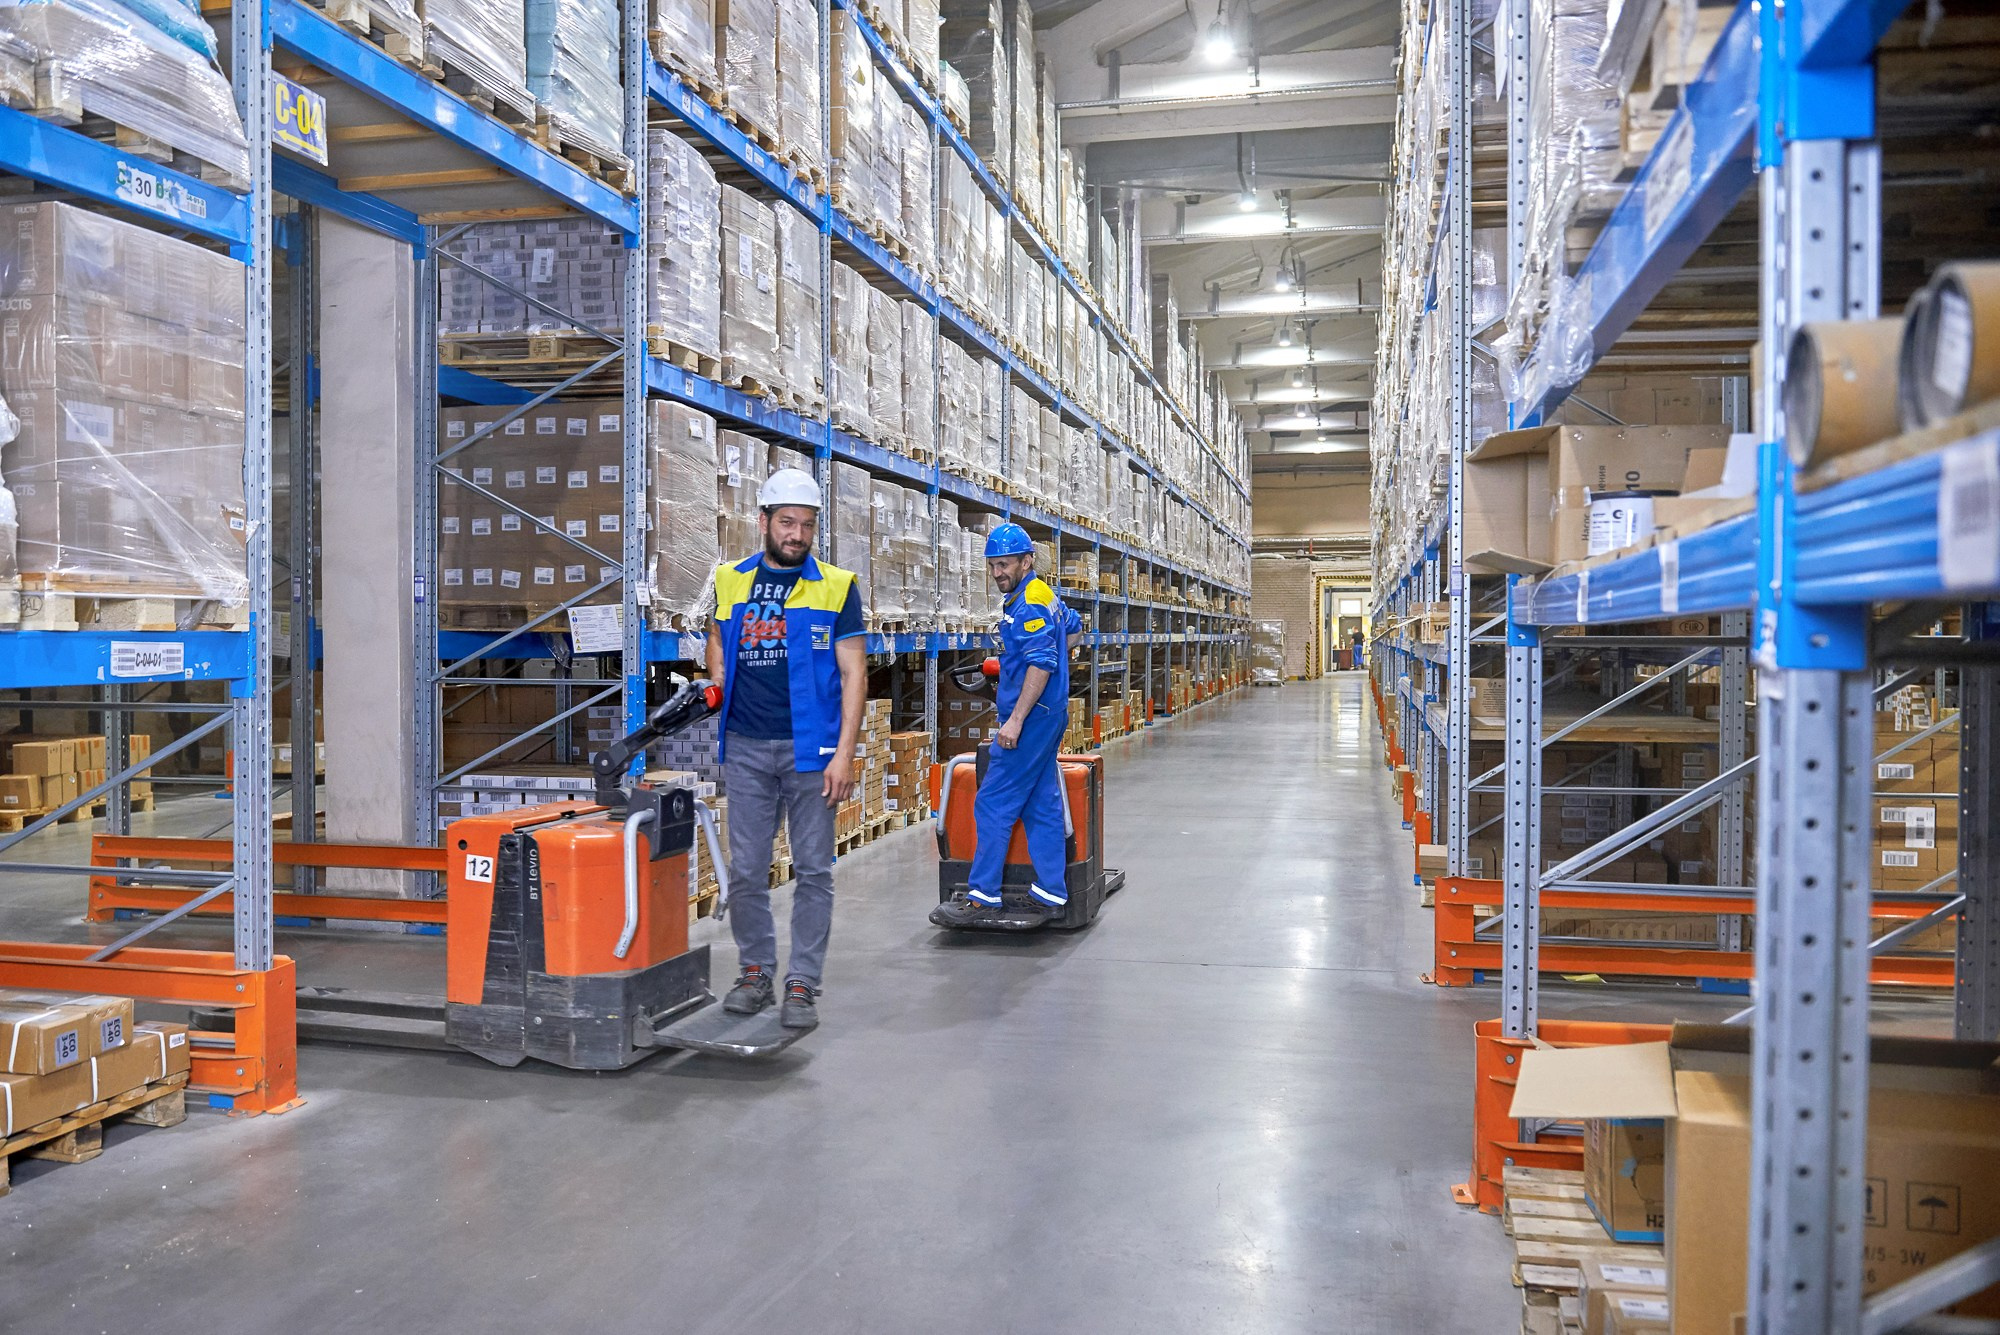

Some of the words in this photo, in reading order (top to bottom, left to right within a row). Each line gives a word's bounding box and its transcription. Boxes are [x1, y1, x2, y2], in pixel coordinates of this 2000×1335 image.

[275, 83, 323, 138] C-04
[135, 177, 152, 197] 30
[748, 583, 793, 600] PERI
[468, 857, 491, 878] 12
[529, 885, 539, 900] BT
[68, 1032, 76, 1052] ECO
[106, 1021, 114, 1043] 3-40
[61, 1036, 69, 1058] 3-40
